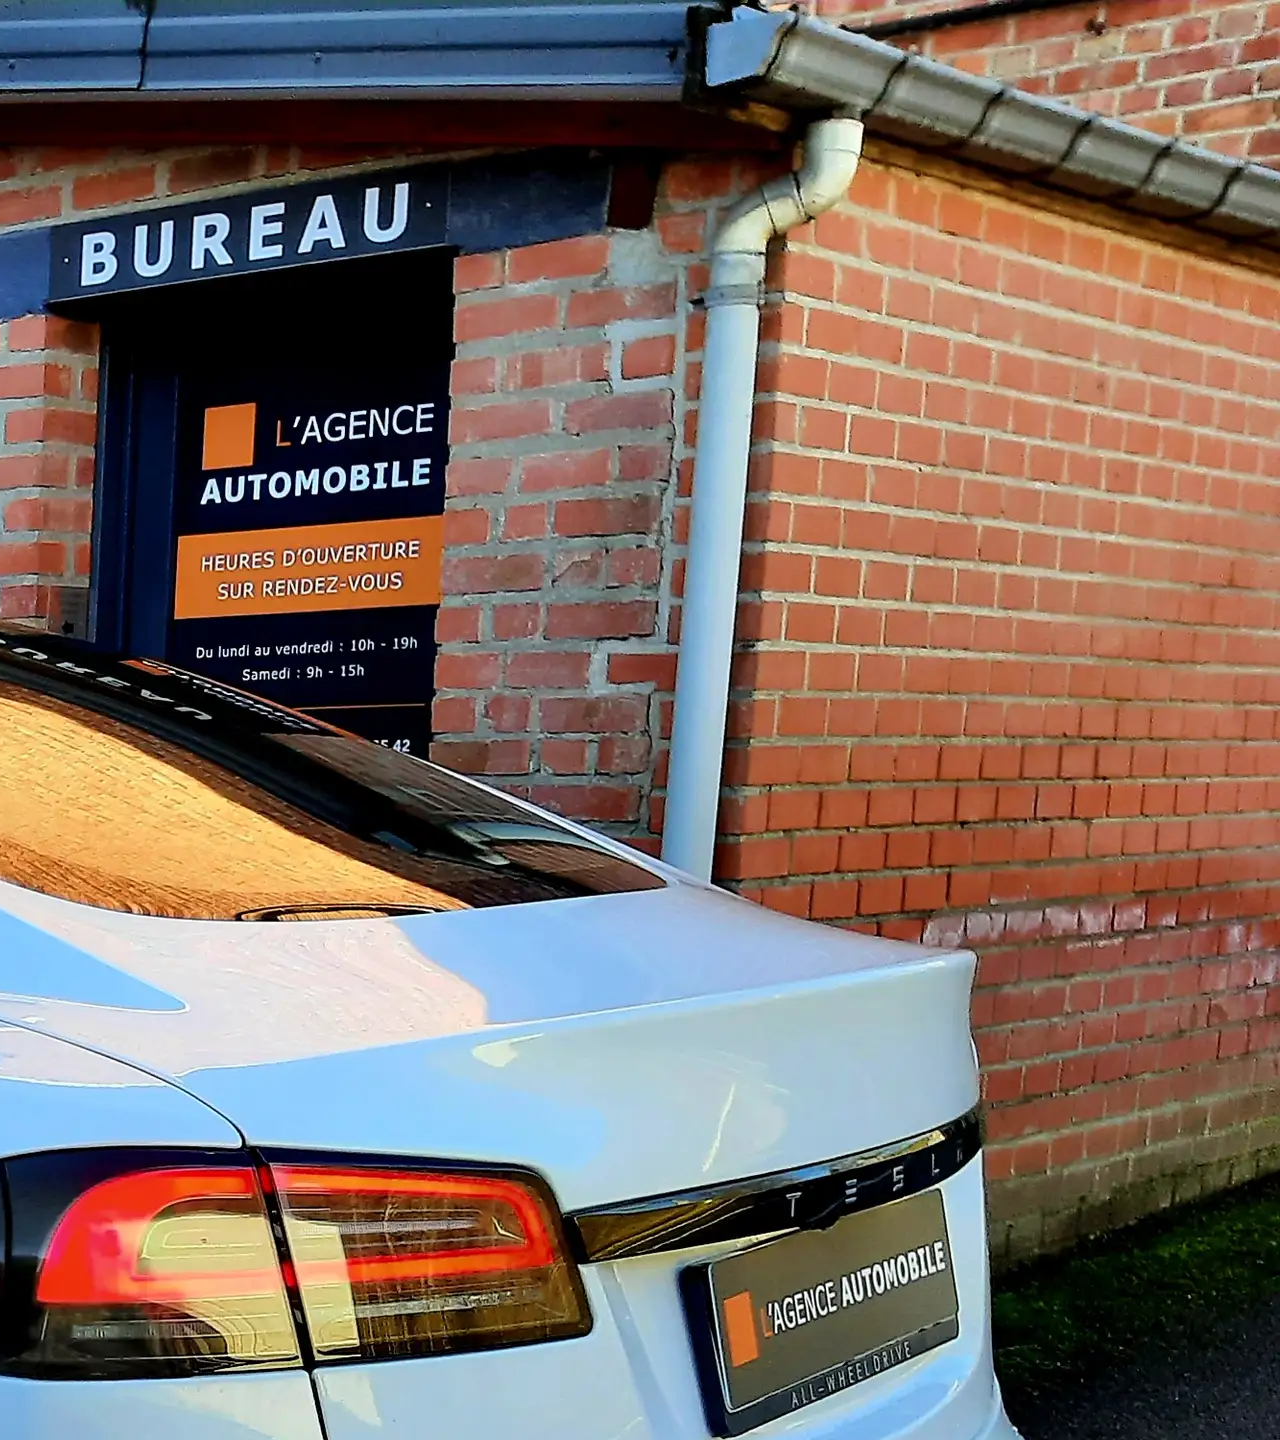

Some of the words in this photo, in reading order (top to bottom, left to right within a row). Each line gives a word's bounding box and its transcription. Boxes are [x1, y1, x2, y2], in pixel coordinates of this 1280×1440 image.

[80, 182, 409, 287] BUREAU
[276, 402, 435, 447] L'AGENCE
[200, 457, 432, 505] AUTOMOBILE
[200, 551, 275, 572] HEURES
[282, 540, 421, 567] D'OUVERTURE
[217, 582, 255, 600] SUR
[262, 572, 403, 598] RENDEZ-VOUS
[196, 647, 213, 659] Du
[218, 644, 250, 658] lundi
[254, 646, 271, 656] au
[275, 640, 333, 656] vendredi
[350, 639, 375, 652] 10h
[392, 637, 418, 650] 19h
[242, 667, 291, 681] Samedi
[306, 666, 323, 679] 9h
[340, 664, 365, 677] 15h
[392, 738, 411, 752] 42
[760, 1280, 839, 1338] L'AGENCE
[840, 1240, 946, 1308] AUTOMOBILE
